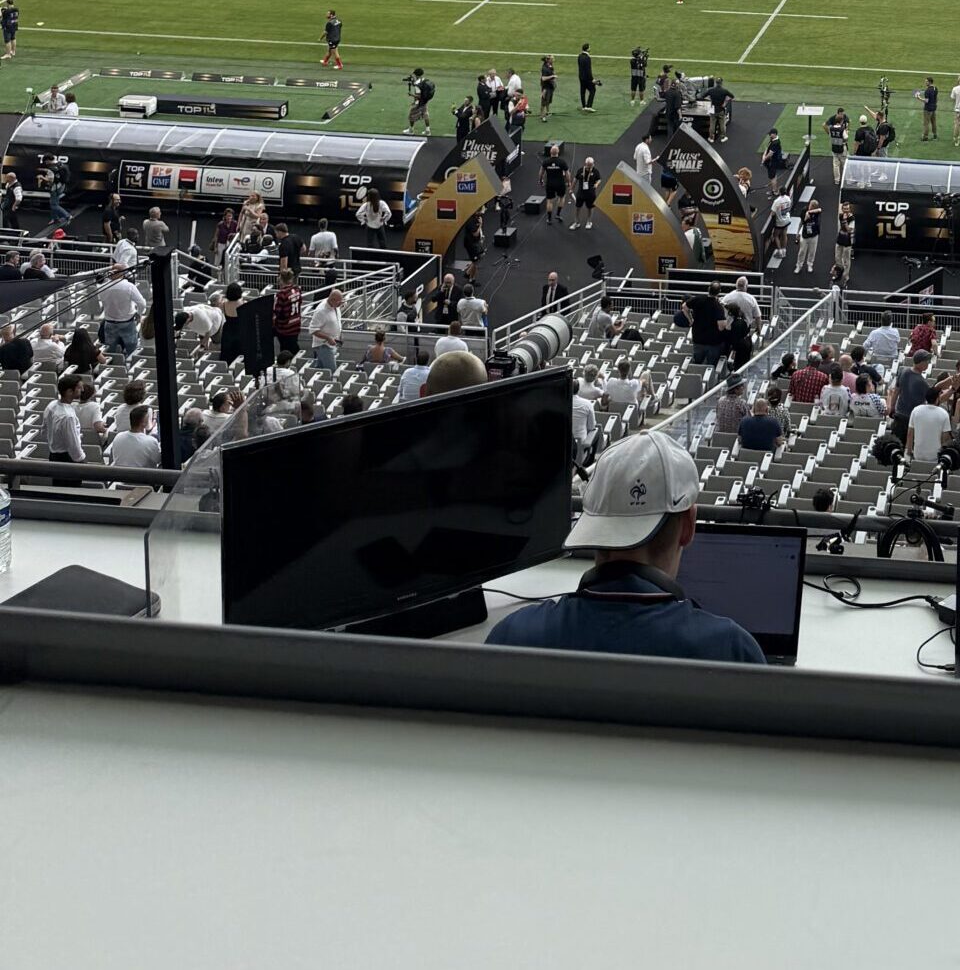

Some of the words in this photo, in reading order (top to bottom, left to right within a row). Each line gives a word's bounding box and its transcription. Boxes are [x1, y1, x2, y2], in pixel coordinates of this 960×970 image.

[462, 138, 495, 153] Phase
[668, 149, 701, 162] Phase
[671, 158, 703, 171] FINALE
[152, 178, 170, 186] GMF
[339, 174, 372, 185] TOP
[457, 182, 478, 193] GMF
[875, 201, 910, 212] TOP
[633, 222, 653, 233] GMF
